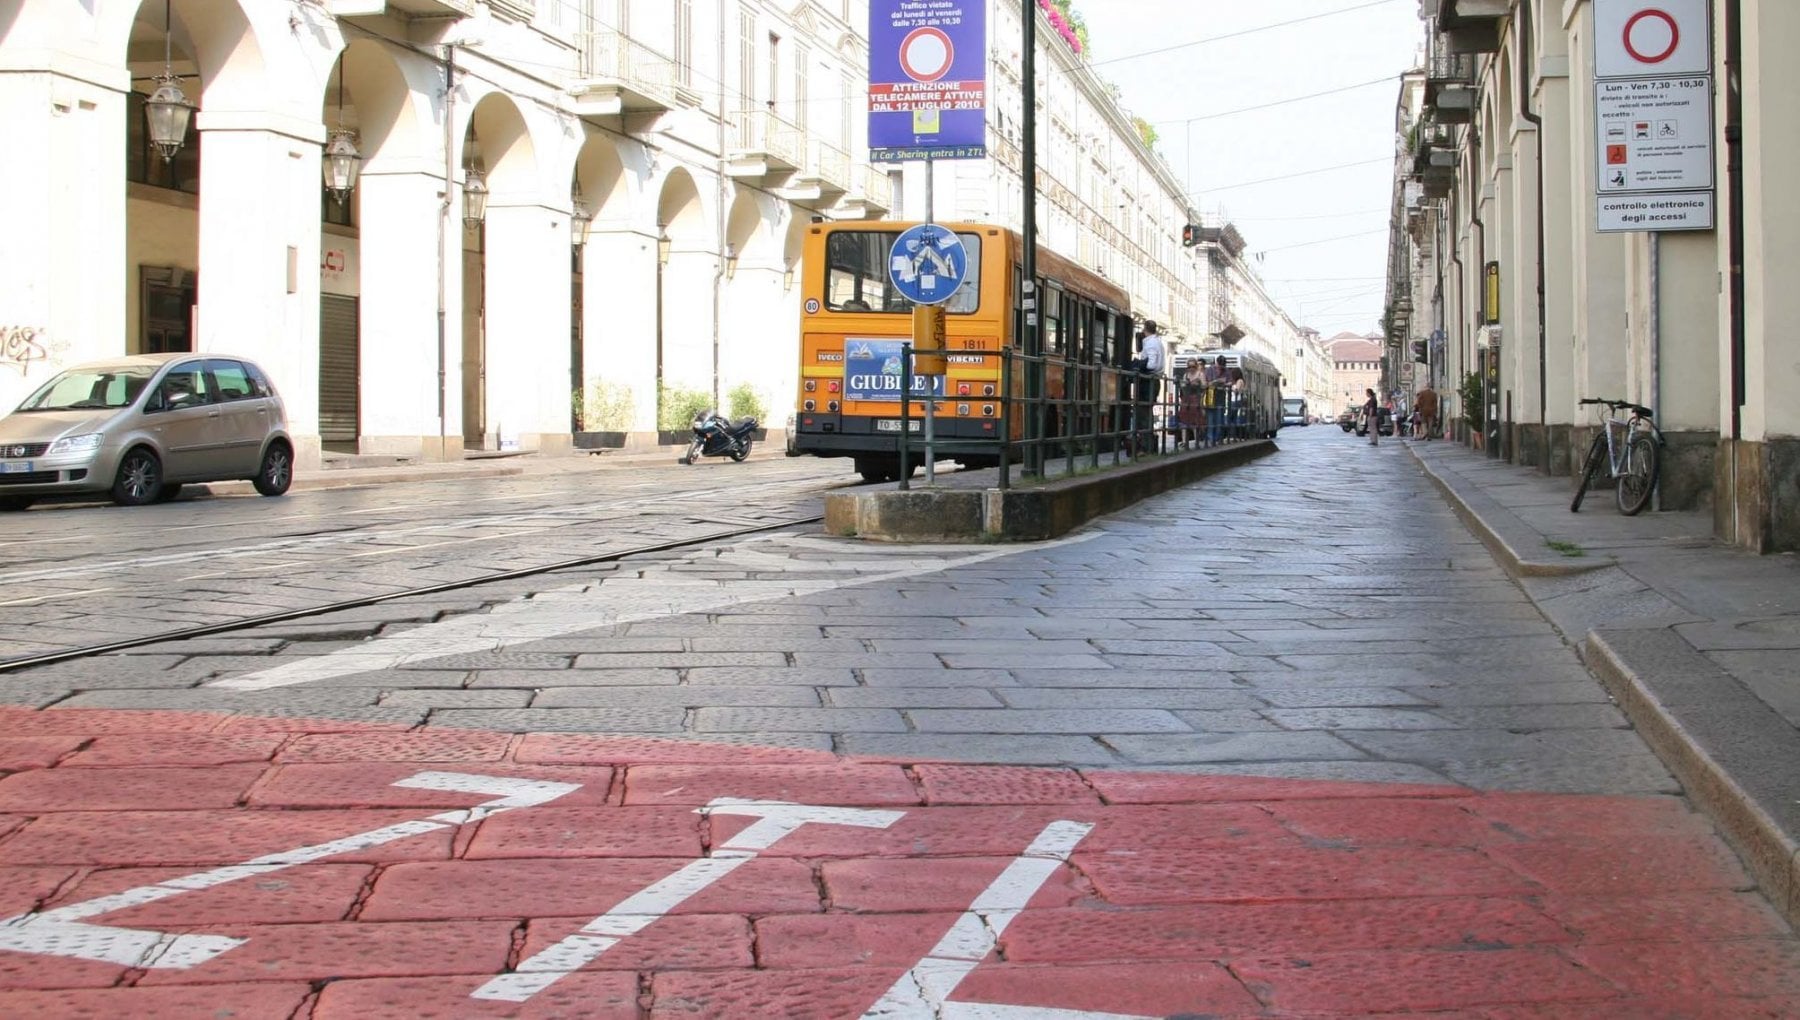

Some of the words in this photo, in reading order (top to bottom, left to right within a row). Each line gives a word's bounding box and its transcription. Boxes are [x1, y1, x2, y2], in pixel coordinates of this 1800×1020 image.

[942, 17, 960, 25] 10,30
[893, 82, 960, 92] ATTENZIONE
[1651, 82, 1670, 90] 7,30
[871, 92, 941, 102] TELECAMERE
[944, 91, 983, 100] ATTIVE
[872, 103, 894, 111] DAL
[896, 103, 909, 111] 12
[912, 101, 952, 110] LUGLIO
[955, 100, 981, 109] 2010
[880, 152, 894, 161] Car
[896, 150, 929, 160] Sharing
[931, 149, 954, 157] entra
[956, 147, 965, 156] in
[967, 147, 984, 156] ZTL
[1622, 213, 1646, 222] degli
[807, 302, 817, 311] 80
[962, 340, 986, 349] 1811
